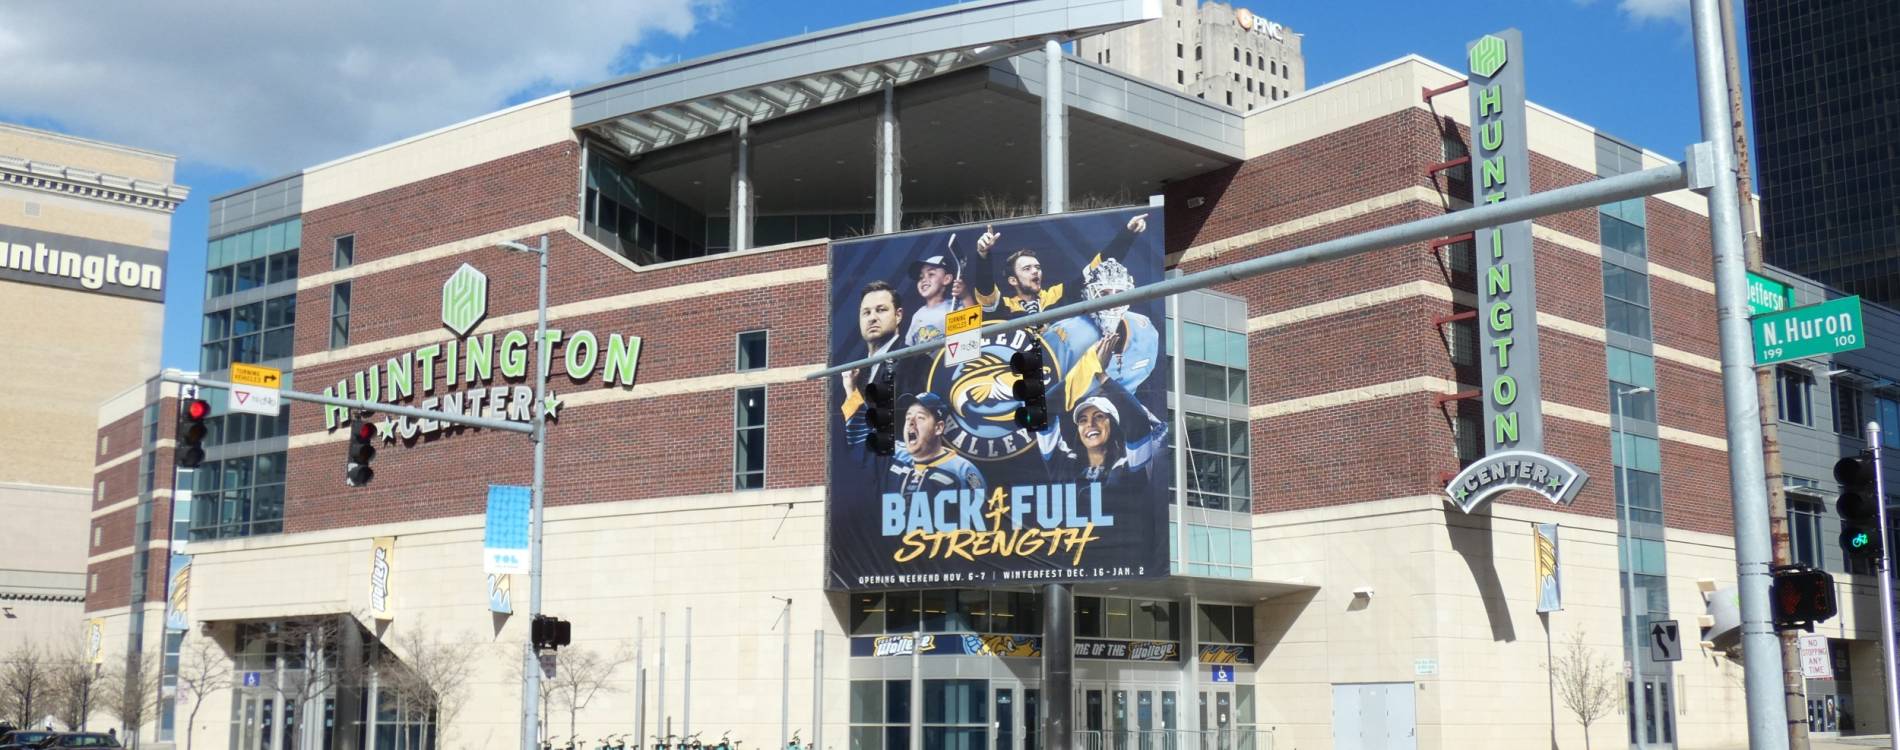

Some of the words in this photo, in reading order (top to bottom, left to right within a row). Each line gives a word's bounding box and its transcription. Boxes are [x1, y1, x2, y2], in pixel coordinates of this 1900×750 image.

[1252, 15, 1283, 41] PNC
[1479, 84, 1518, 443] HUNTINGTON
[1835, 333, 1856, 348] 100
[1763, 348, 1783, 360] 199
[323, 329, 641, 431] HUNTINGTON
[399, 386, 533, 439] CENTER
[943, 414, 1033, 457] WALLEY
[1464, 460, 1548, 492] CENTER
[881, 487, 987, 537] BACK
[1010, 482, 1114, 530] FULL
[893, 521, 1102, 566] STRENGTH
[858, 575, 896, 585] OPENING
[898, 574, 940, 583] WEEKEND
[943, 572, 965, 582] NOV.
[1003, 569, 1063, 580] WINTERFEST
[1066, 568, 1089, 577] DEC.
[878, 635, 931, 656] Wallee
[1092, 644, 1105, 656] OF
[1107, 644, 1127, 657] THE
[1808, 639, 1818, 647] NO
[1808, 656, 1822, 665] ANY
[1808, 665, 1825, 674] TIME
